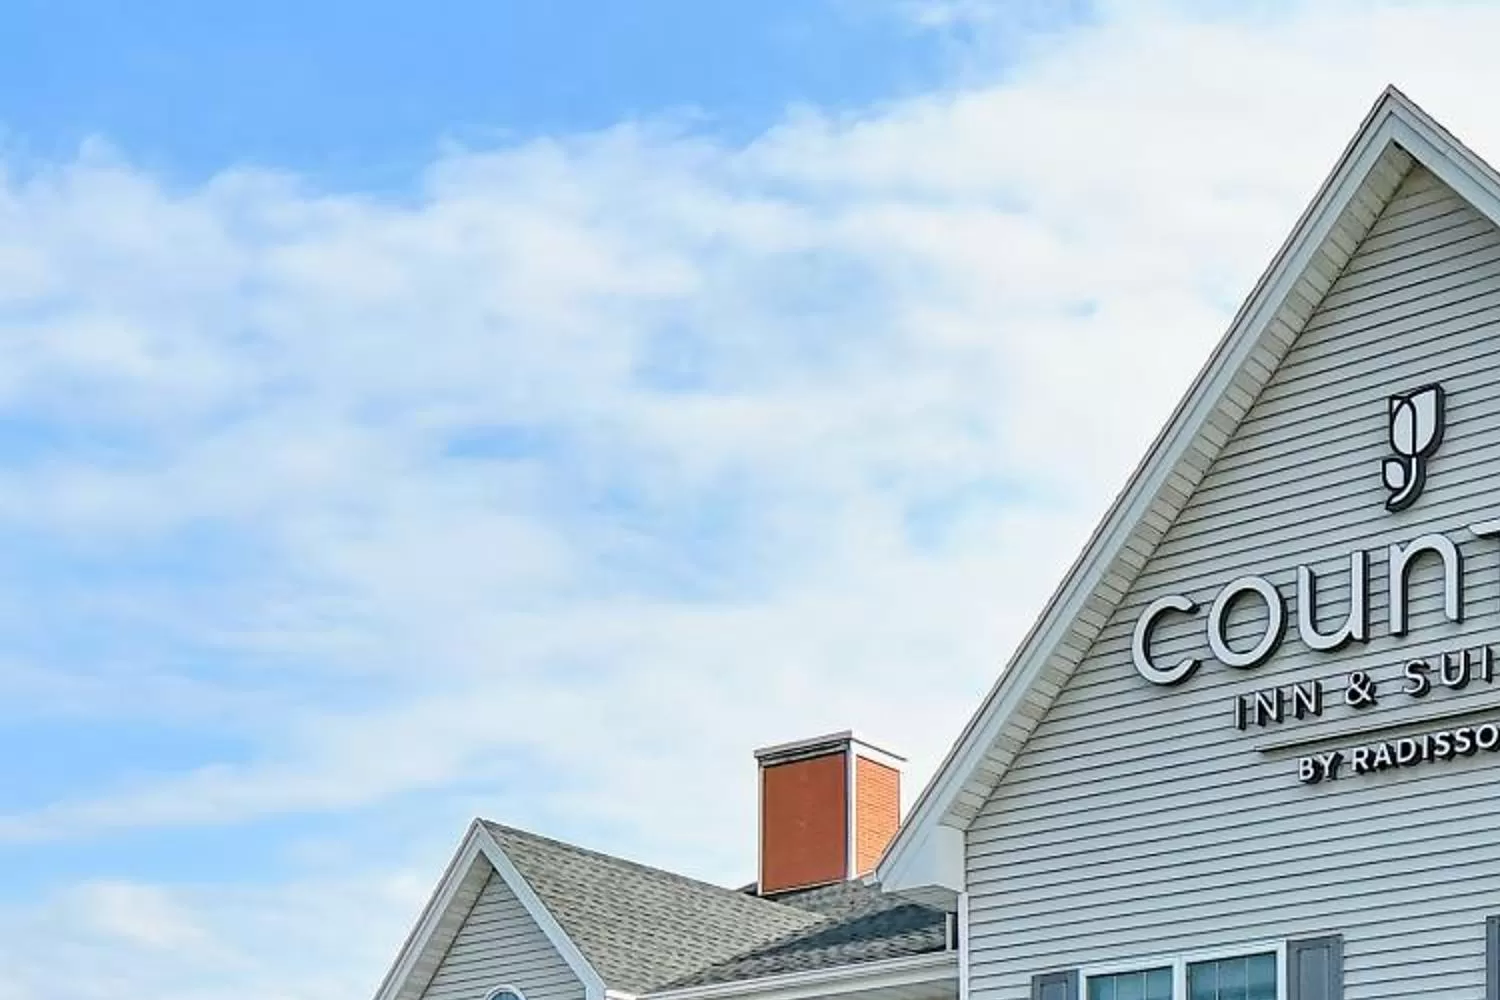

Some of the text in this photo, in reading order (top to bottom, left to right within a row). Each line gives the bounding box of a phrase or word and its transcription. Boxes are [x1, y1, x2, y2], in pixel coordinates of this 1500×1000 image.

[1233, 679, 1322, 730] INN
[1344, 670, 1377, 707] &
[1298, 751, 1344, 783] BY
